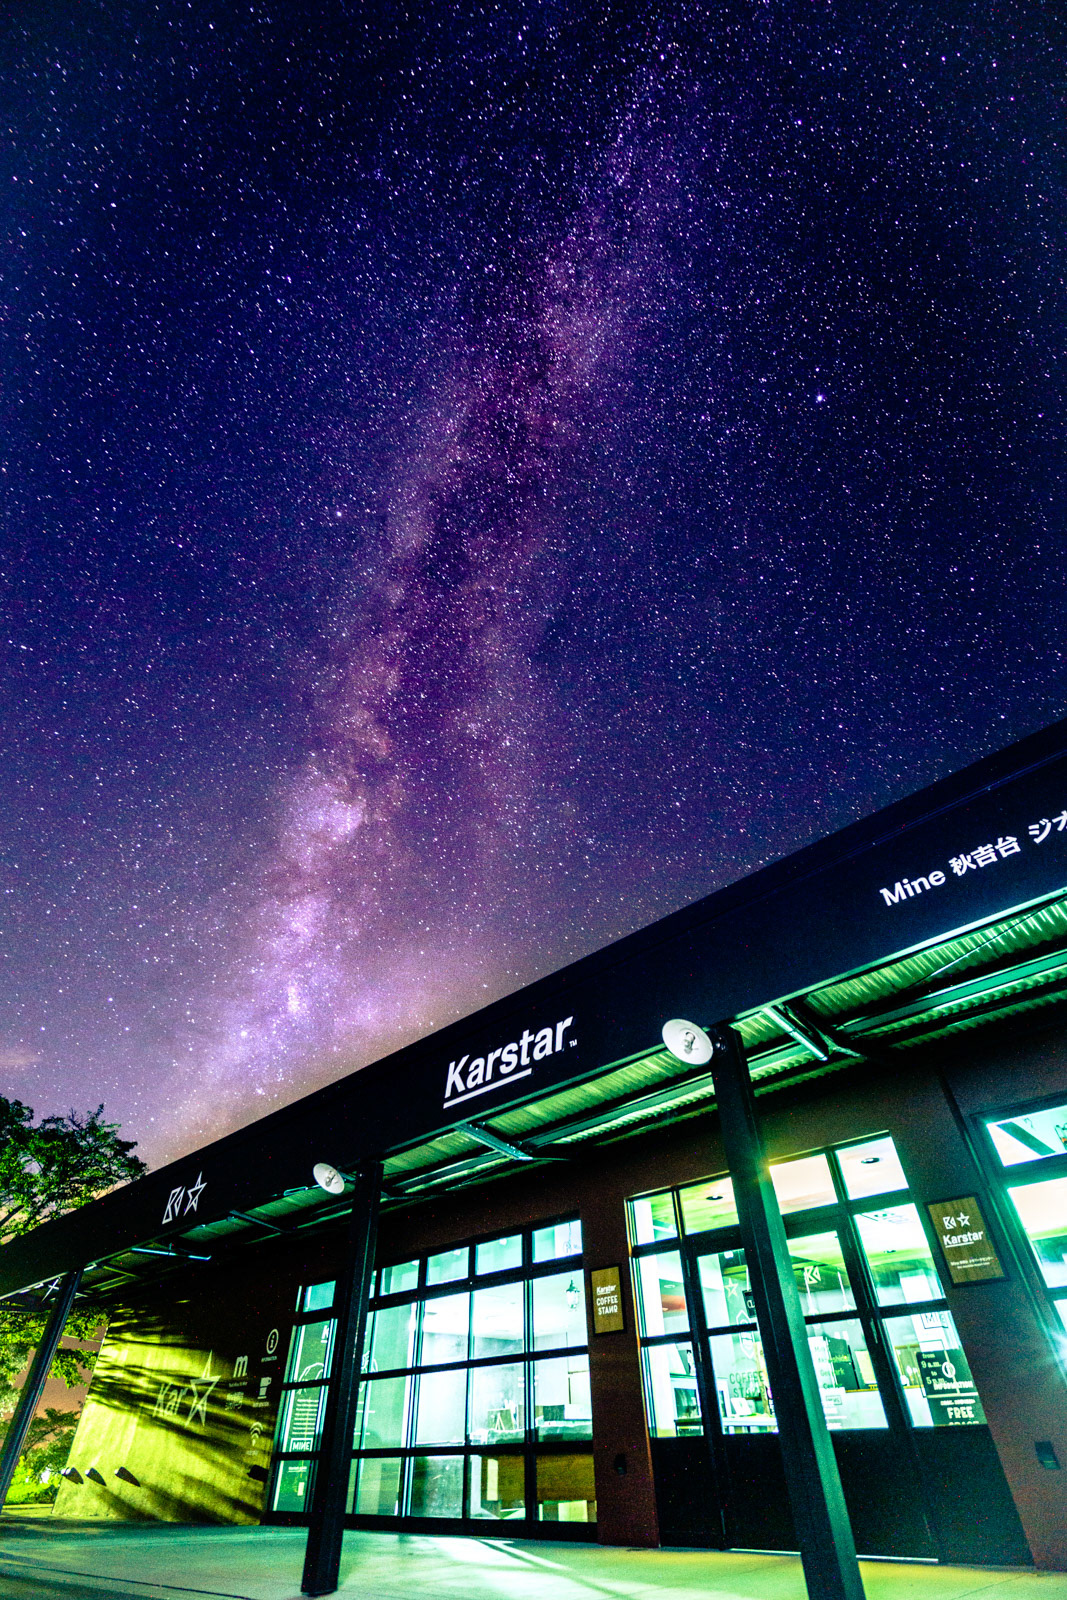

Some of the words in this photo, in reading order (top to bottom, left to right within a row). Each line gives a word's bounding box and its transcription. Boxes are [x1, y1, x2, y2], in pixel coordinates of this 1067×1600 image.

[880, 870, 946, 906] Mine
[948, 835, 1021, 877] 秋吉台
[444, 1016, 573, 1099] Karstar
[943, 1231, 984, 1246] Karstar
[596, 1295, 618, 1306] COFFEE
[946, 1406, 975, 1420] FREE
